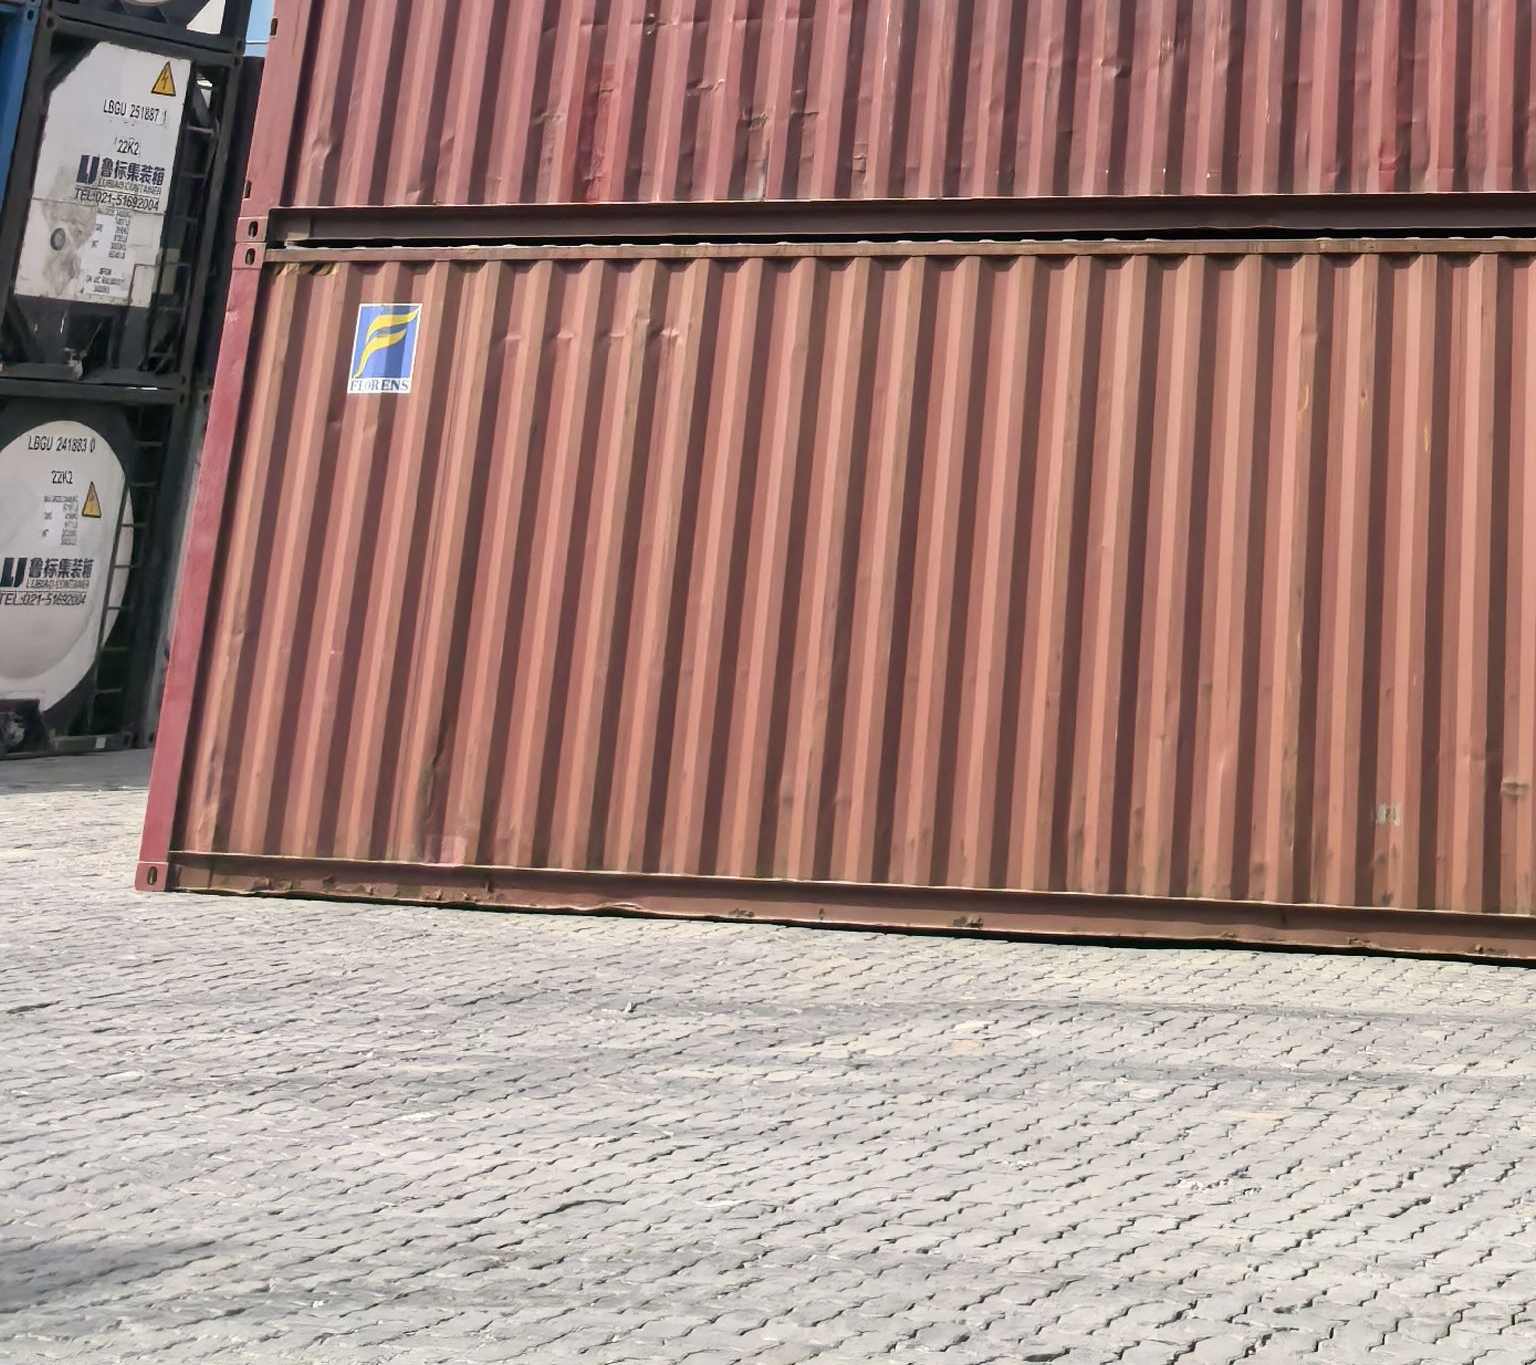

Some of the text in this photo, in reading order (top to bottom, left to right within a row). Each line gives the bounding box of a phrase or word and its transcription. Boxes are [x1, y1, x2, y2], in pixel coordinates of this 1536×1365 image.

[103, 99, 127, 116] LBGU
[117, 139, 140, 156] 22K2
[101, 157, 166, 186] 鲁标集装箱
[349, 379, 409, 391] FLORENS
[28, 435, 54, 451] LBGU
